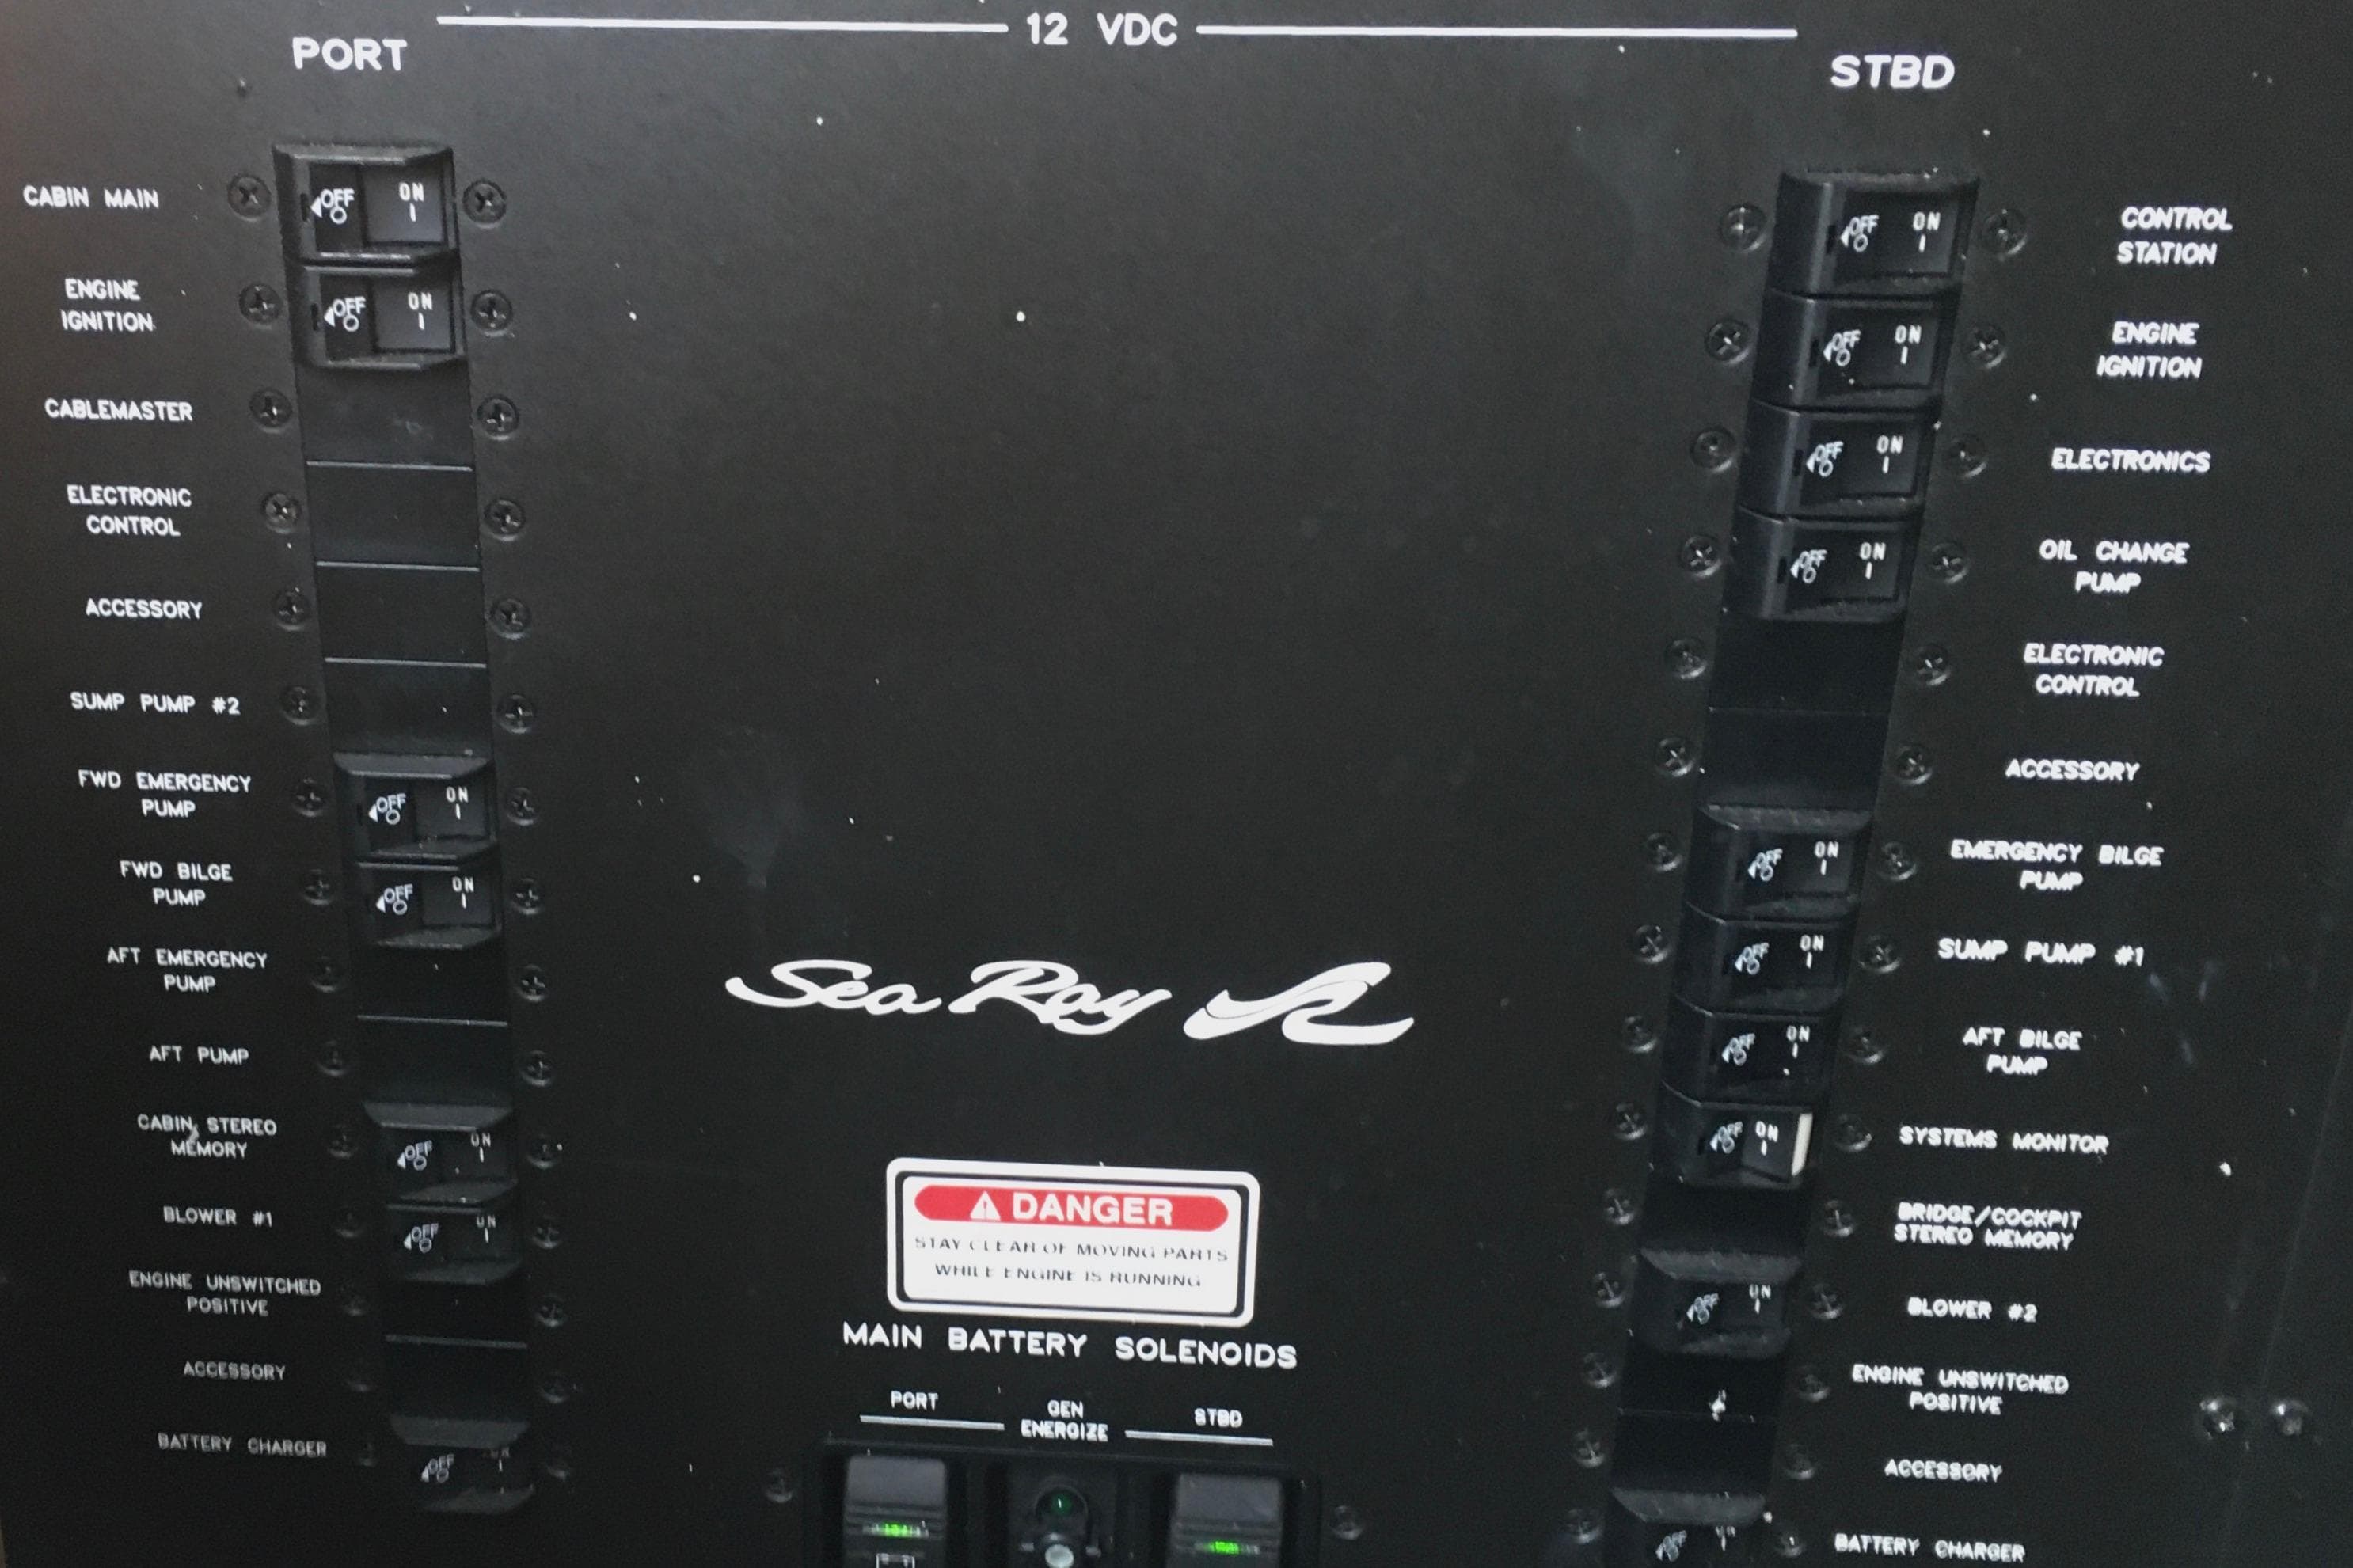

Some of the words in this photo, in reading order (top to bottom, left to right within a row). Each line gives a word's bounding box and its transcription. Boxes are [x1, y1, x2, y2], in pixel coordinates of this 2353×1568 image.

[1027, 12, 1068, 45] 12
[1097, 13, 1177, 46] VDC
[292, 37, 408, 70] PORT
[1830, 55, 1955, 89] STBD
[23, 185, 89, 207] CABIN
[105, 188, 158, 208] MAIN
[321, 189, 355, 207] OFF
[399, 183, 424, 201] ON
[1849, 215, 1880, 233] OFF
[1914, 212, 1941, 231] ON
[2121, 207, 2233, 230] CONTROL
[2117, 241, 2217, 264] STATION
[65, 278, 140, 300] ENGINE
[333, 298, 367, 317] OFF
[409, 293, 433, 311] ON
[61, 310, 155, 332] IGNITION
[1831, 330, 1861, 350] OFF
[1895, 325, 1921, 344] ON
[2112, 321, 2199, 345] ENGINE
[2097, 355, 2202, 378] IGNITION
[45, 398, 192, 421] CABLEMASTER
[1814, 442, 1844, 461] OFF
[1877, 435, 1903, 454] ON
[2051, 447, 2210, 473] ELECTRONICS
[67, 485, 192, 507] ELECTRONIC
[86, 515, 181, 536] CONTROL
[1798, 549, 1827, 568] OFF
[1860, 543, 1885, 560] ON
[2039, 539, 2077, 560] OIL
[2096, 541, 2190, 564] CHANGE
[2075, 571, 2141, 594] PUMP
[86, 598, 202, 618] ACCESSORY
[2024, 643, 2165, 666] ELECTRONIC
[2036, 674, 2139, 697] CONTROL
[70, 692, 124, 710] SUMP
[140, 694, 195, 712] PUMP
[212, 697, 240, 714] #2
[78, 769, 121, 788] FWD
[136, 772, 251, 792] EMERGENCY
[2005, 759, 2140, 781] ACCESSORY
[376, 794, 406, 812] OFF
[445, 787, 469, 803] ON
[142, 799, 196, 817] PUMP
[1814, 842, 1838, 858] ON
[1951, 839, 2083, 863] EMERGENCY
[2098, 845, 2164, 866] BILGE
[120, 860, 162, 879] FWD
[177, 863, 232, 881] BILGE
[2020, 870, 2083, 890] PUMP
[383, 884, 414, 903] OFF
[452, 877, 474, 893] ON
[153, 888, 205, 905] PUMP
[1800, 936, 1824, 951] ON
[1938, 938, 2008, 960] SUMP
[2024, 941, 2096, 964] PUMP
[2115, 946, 2144, 966] #1
[108, 947, 140, 963] AFT
[156, 949, 267, 968] EMERGENCY
[164, 974, 215, 992] PUMP
[725, 959, 941, 1015] Sea
[948, 960, 1172, 1035] Ray
[1786, 1026, 1810, 1042] ON
[1963, 1027, 2005, 1046] AFT
[2019, 1029, 2082, 1050] BILGE
[150, 1046, 182, 1061] AFT
[198, 1047, 249, 1064] PUMP
[1986, 1054, 2047, 1075] PUMP
[137, 1114, 193, 1133] CABIN
[207, 1117, 276, 1135] STEREO
[1755, 1122, 1778, 1143] ON
[171, 1140, 248, 1159] MEMORY
[405, 1141, 432, 1160] OFF
[1899, 1126, 1998, 1148] SYSTEMS
[2013, 1133, 2109, 1154] MONITOR
[164, 1206, 236, 1224] BLOWER
[253, 1211, 272, 1226] #1
[1011, 1192, 1175, 1228] DANGER
[1899, 1203, 2082, 1228] BRIDGE/COCKPIT
[1894, 1224, 1973, 1245] STEREO
[1984, 1228, 2074, 1250] MEMORY
[129, 1270, 192, 1289] ENGINE
[207, 1275, 321, 1295] UNSWITCHED
[187, 1297, 268, 1316] POSITIVE
[1907, 1297, 1992, 1319] BLOWER
[2008, 1304, 2037, 1322] #2
[843, 1322, 922, 1348] MAIN
[948, 1327, 1087, 1357] BATTERY
[1116, 1337, 1297, 1369] SOLENOIDS
[184, 1361, 285, 1380] ACCESSORY
[1852, 1364, 1924, 1386] ENGINE
[1938, 1369, 2069, 1394] UNSWITCHED
[891, 1391, 938, 1410] PORT
[1047, 1400, 1083, 1418] GEN
[1910, 1391, 2002, 1414] POSITIVE
[1195, 1408, 1242, 1427] STBD
[1021, 1419, 1108, 1441] ENERGIZE
[158, 1433, 231, 1451] BATTERY
[248, 1438, 326, 1457] CHARGER
[1884, 1459, 2002, 1482] ACCESSORY
[1834, 1533, 1919, 1555] BATTERY
[1935, 1540, 2025, 1562] CHARGER
